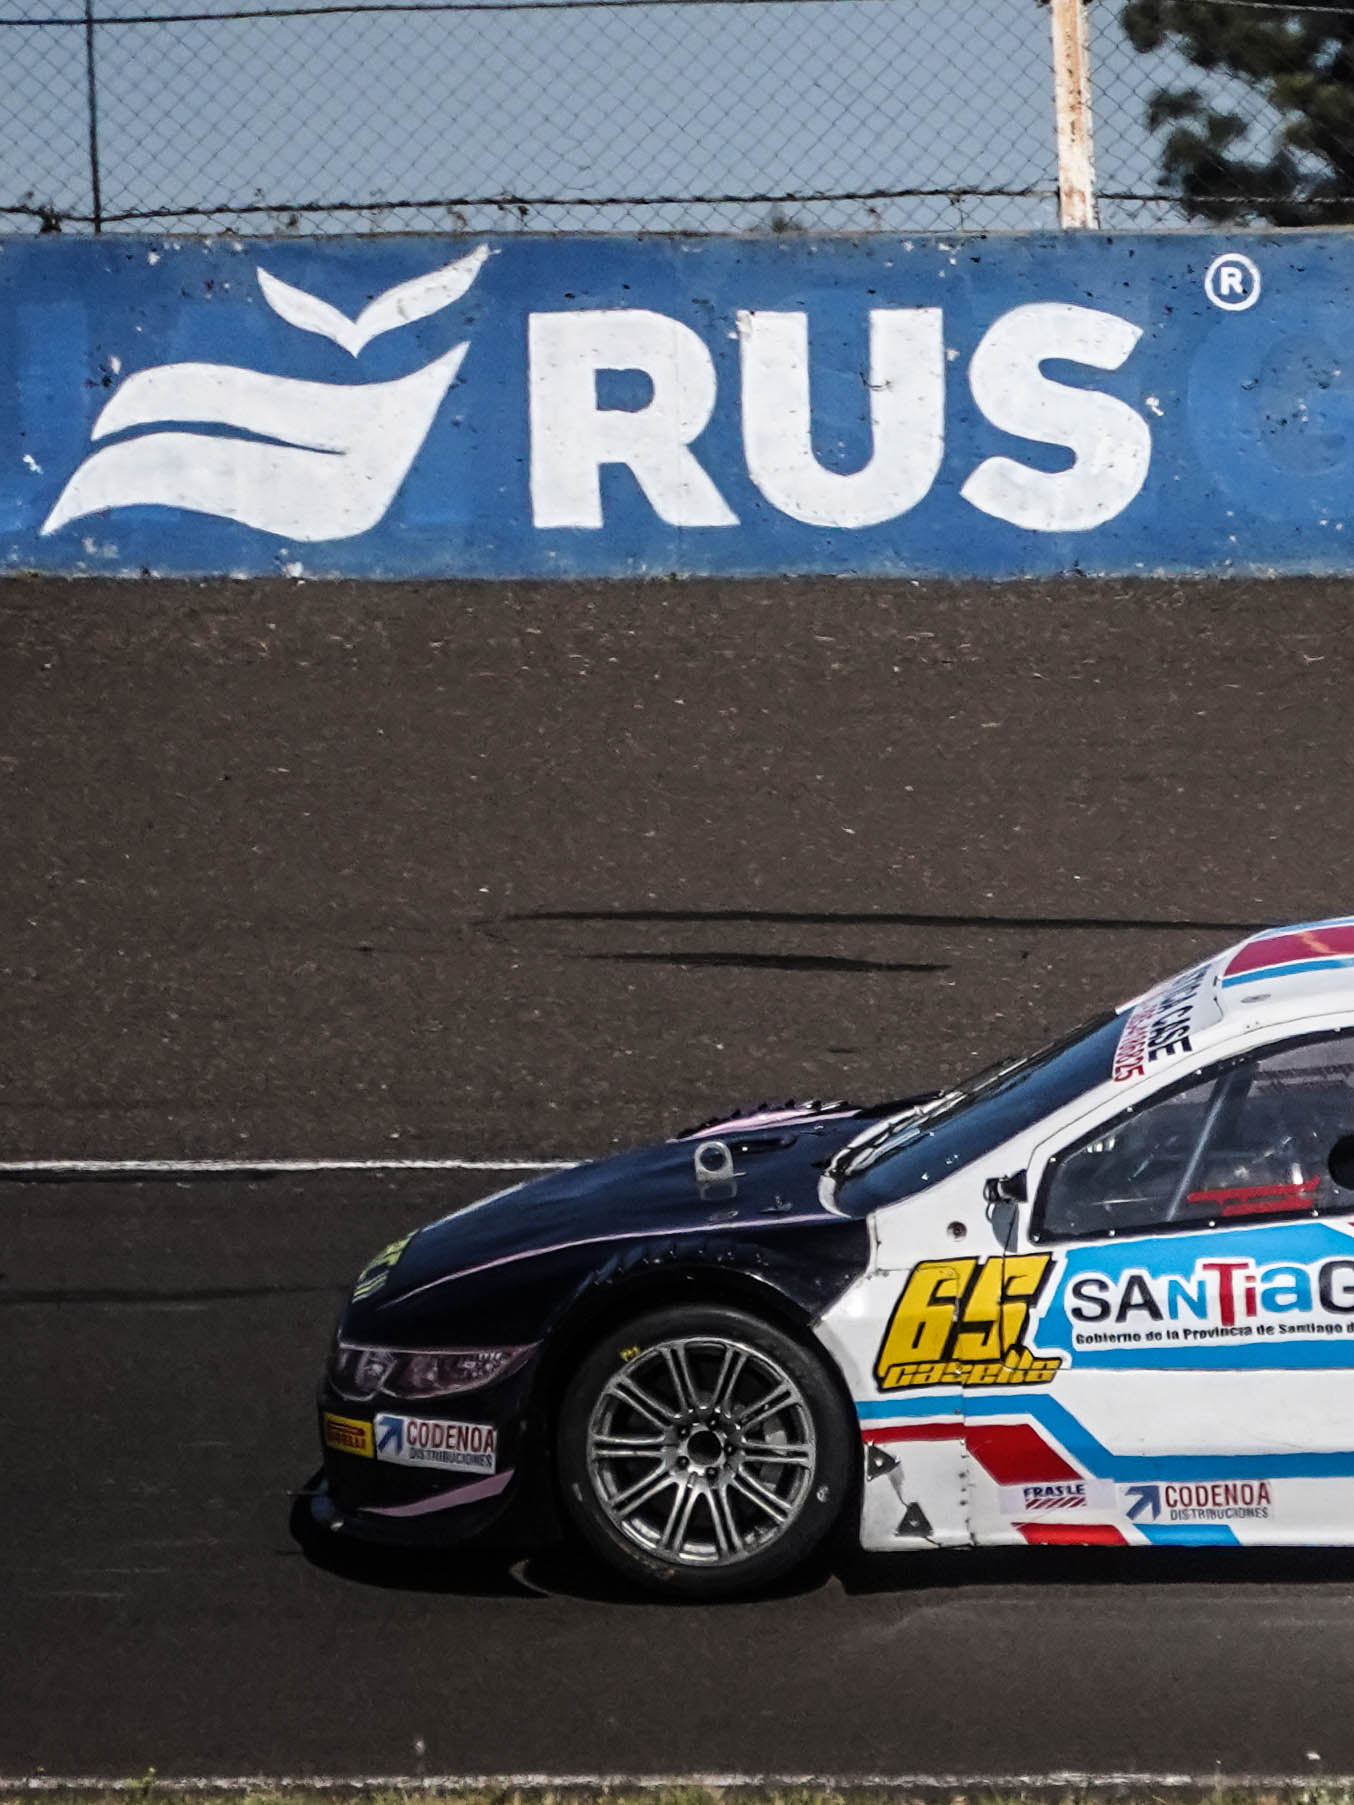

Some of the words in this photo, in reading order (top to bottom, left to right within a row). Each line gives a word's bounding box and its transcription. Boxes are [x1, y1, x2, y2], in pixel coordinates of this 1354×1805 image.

[528, 301, 1152, 532] RUS
[875, 1252, 1055, 1378] 65
[1075, 1331, 1142, 1345] Gobierno
[1145, 1329, 1163, 1341] de
[1166, 1329, 1180, 1340] la
[1183, 1326, 1253, 1340] Provincia
[1256, 1324, 1275, 1336] de
[1278, 1323, 1343, 1335] Santiago
[406, 1420, 496, 1453] CODENOA
[1164, 1482, 1272, 1508] CODENOA
[1169, 1506, 1269, 1521] DISTRIBUCIONES
